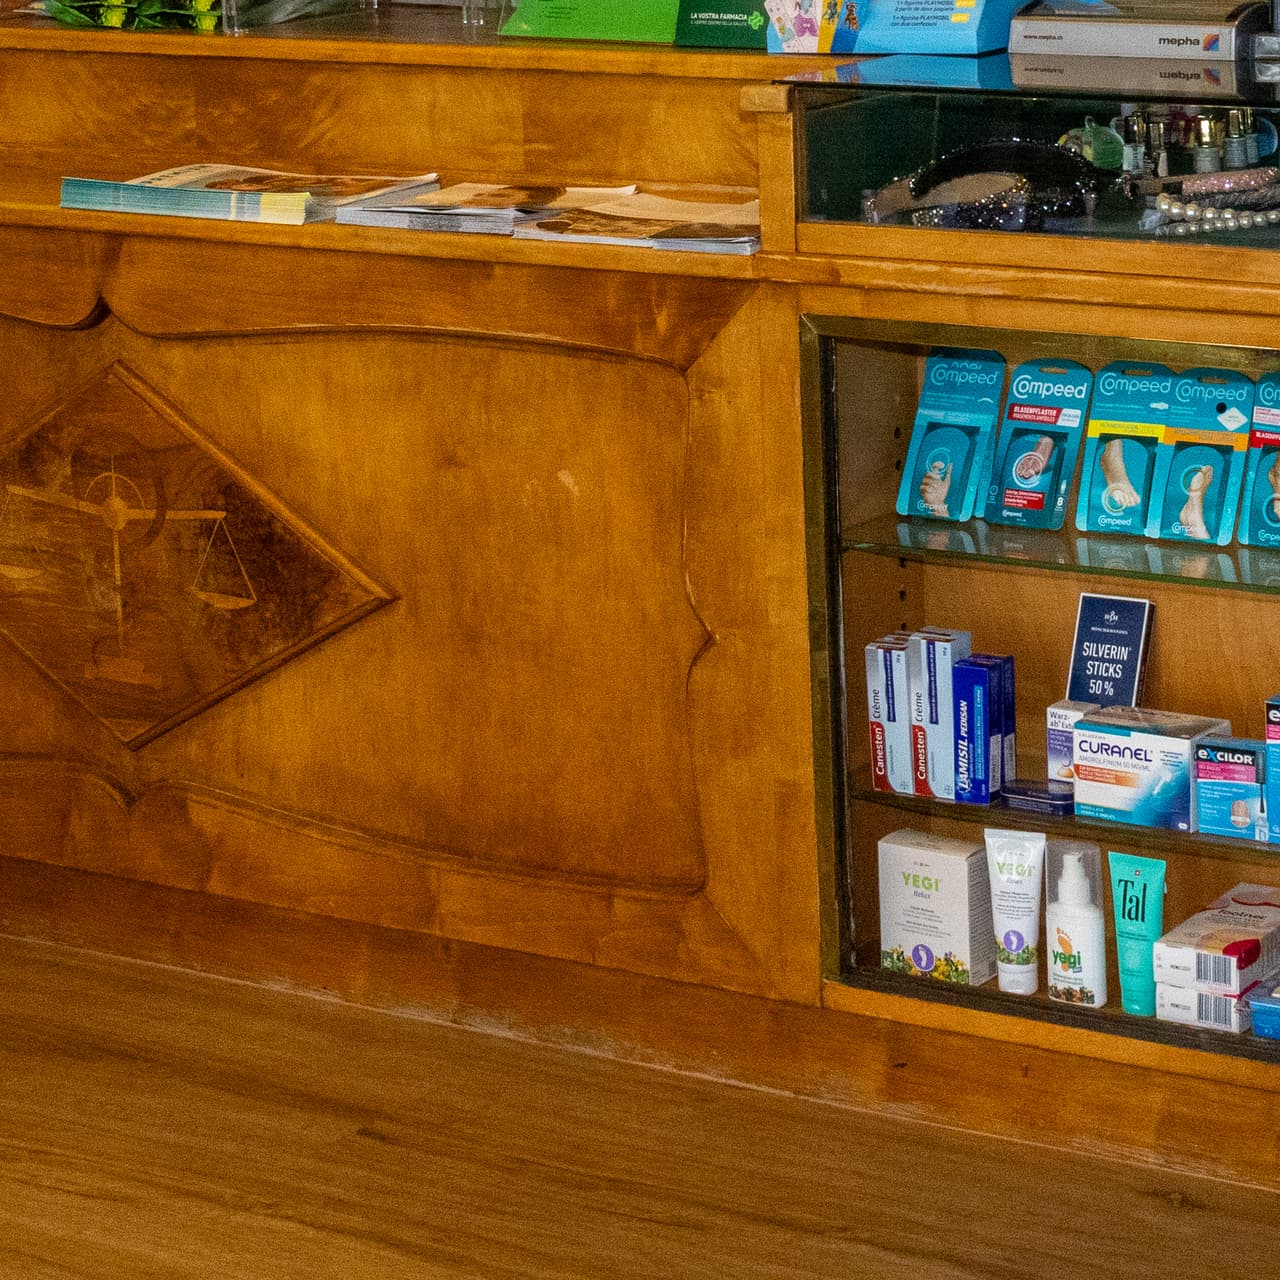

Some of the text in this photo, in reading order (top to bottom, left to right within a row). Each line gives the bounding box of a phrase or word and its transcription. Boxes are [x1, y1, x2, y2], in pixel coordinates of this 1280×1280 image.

[1158, 36, 1200, 47] mepha
[931, 363, 998, 387] Compeed
[1099, 372, 1171, 395] Compeed
[1013, 374, 1087, 400] Compeed
[1175, 379, 1248, 401] Compeed
[1082, 642, 1128, 661] SILVERIN
[1086, 660, 1123, 678] STICKS
[1089, 679, 1114, 696] 50 %
[871, 689, 885, 776] Canesten Crème
[958, 700, 970, 792] LAMISIL PEDISAN
[1079, 740, 1152, 762] CURANEL
[902, 871, 940, 892] YEGI
[1118, 879, 1146, 923] Tal
[1052, 948, 1082, 968] yegi
